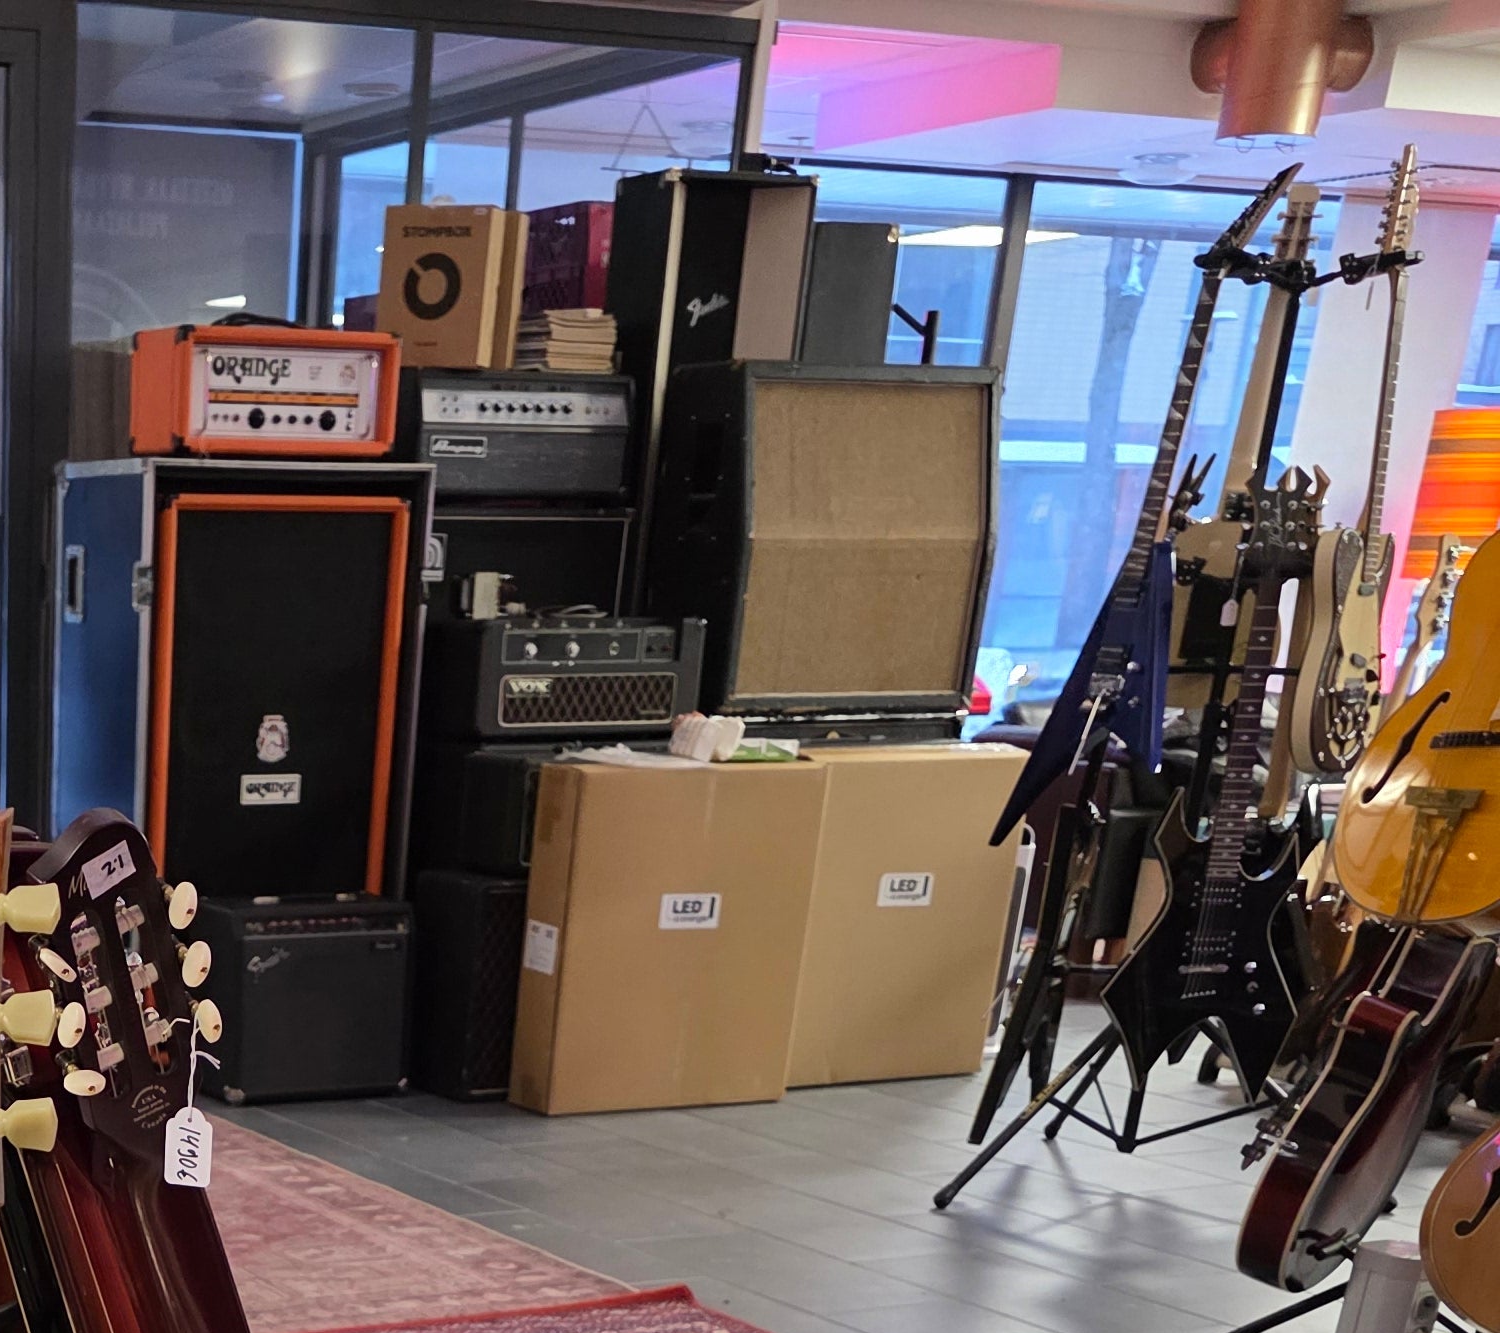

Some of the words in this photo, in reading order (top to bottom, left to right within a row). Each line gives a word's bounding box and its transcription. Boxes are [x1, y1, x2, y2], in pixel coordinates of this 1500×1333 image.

[402, 225, 473, 239] STOMPBOX
[212, 355, 292, 386] ORANGE
[509, 678, 551, 694] VOX
[889, 878, 918, 893] LED
[672, 899, 703, 914] LED
